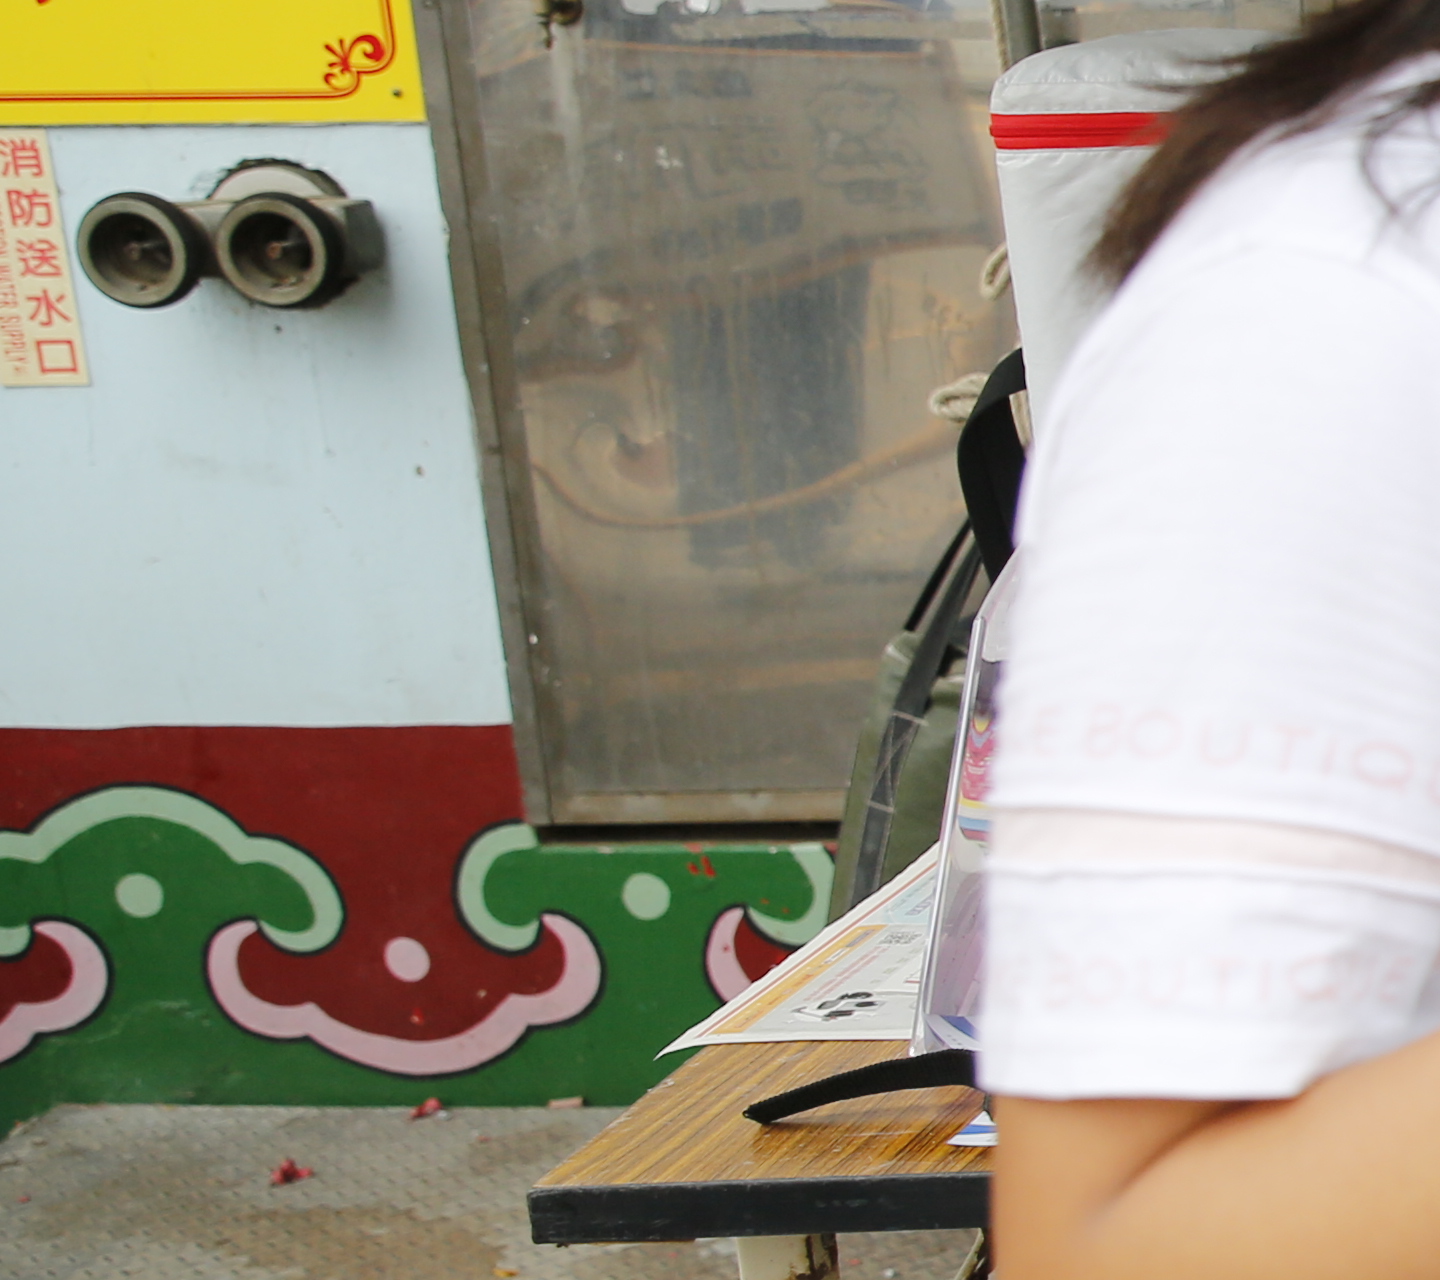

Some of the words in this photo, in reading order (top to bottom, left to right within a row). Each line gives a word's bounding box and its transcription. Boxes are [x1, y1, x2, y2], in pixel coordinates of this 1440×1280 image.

[0, 138, 80, 374] 消防送水口
